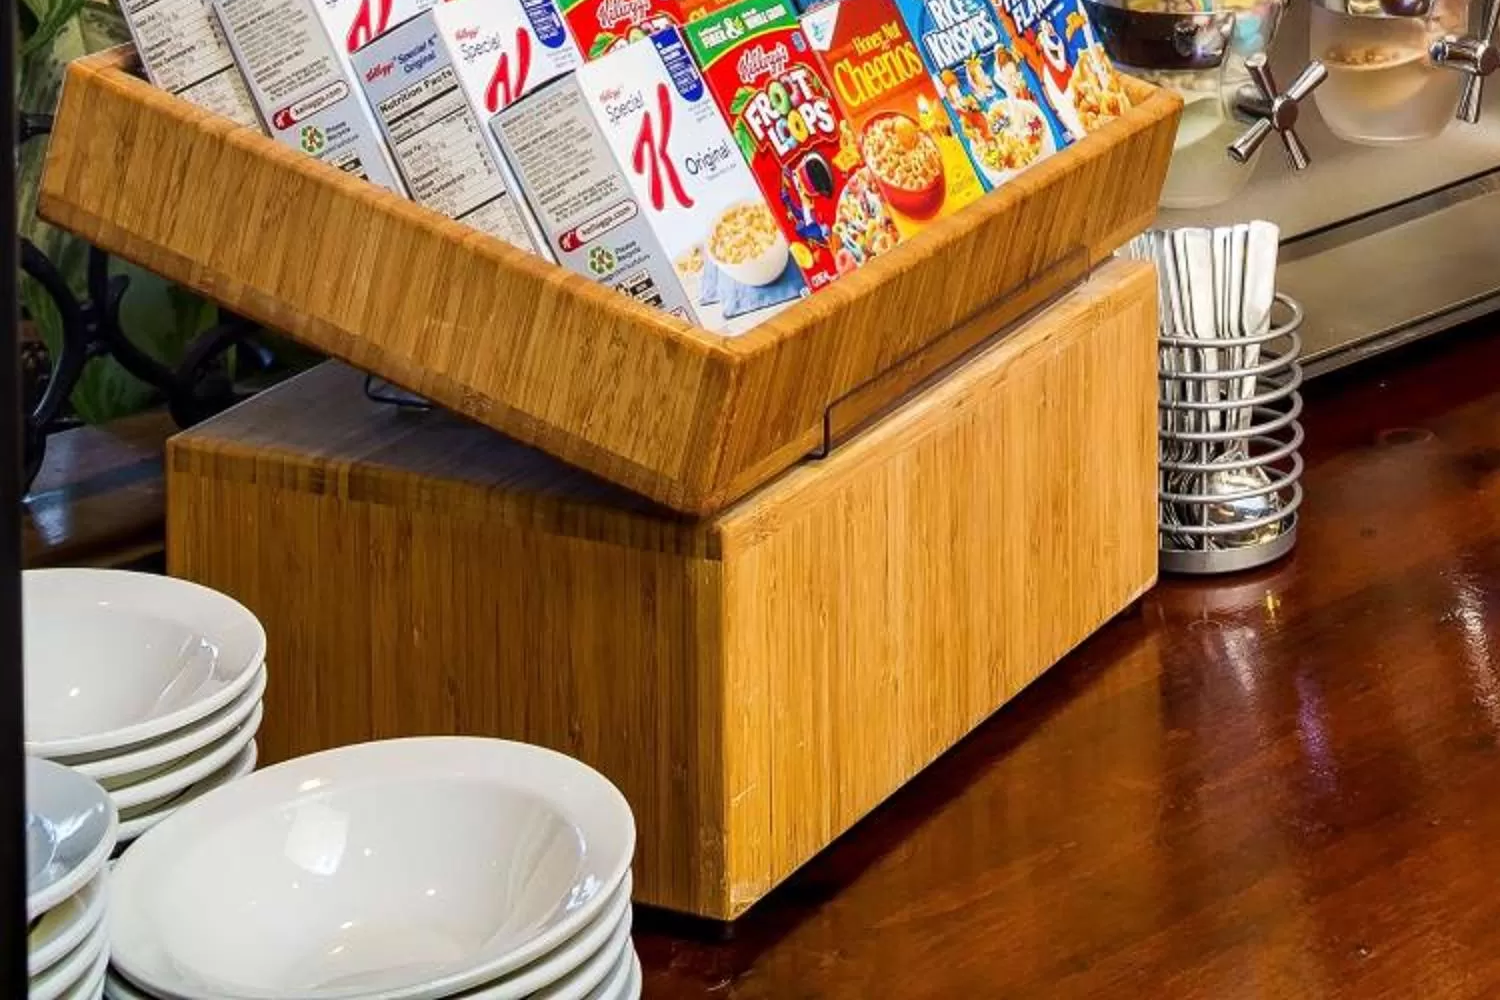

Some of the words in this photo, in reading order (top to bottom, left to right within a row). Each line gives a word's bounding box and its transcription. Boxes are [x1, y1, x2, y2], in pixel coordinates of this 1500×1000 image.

[737, 41, 789, 84] Kellogg's
[852, 28, 882, 55] Honey
[881, 20, 902, 40] Nut
[924, 11, 999, 68] KRISPIES
[833, 42, 925, 107] Cheerios
[606, 90, 645, 128] Special
[744, 68, 813, 141] FROOT
[768, 99, 835, 157] LOOPS
[632, 83, 695, 211] K
[685, 139, 732, 176] Original
